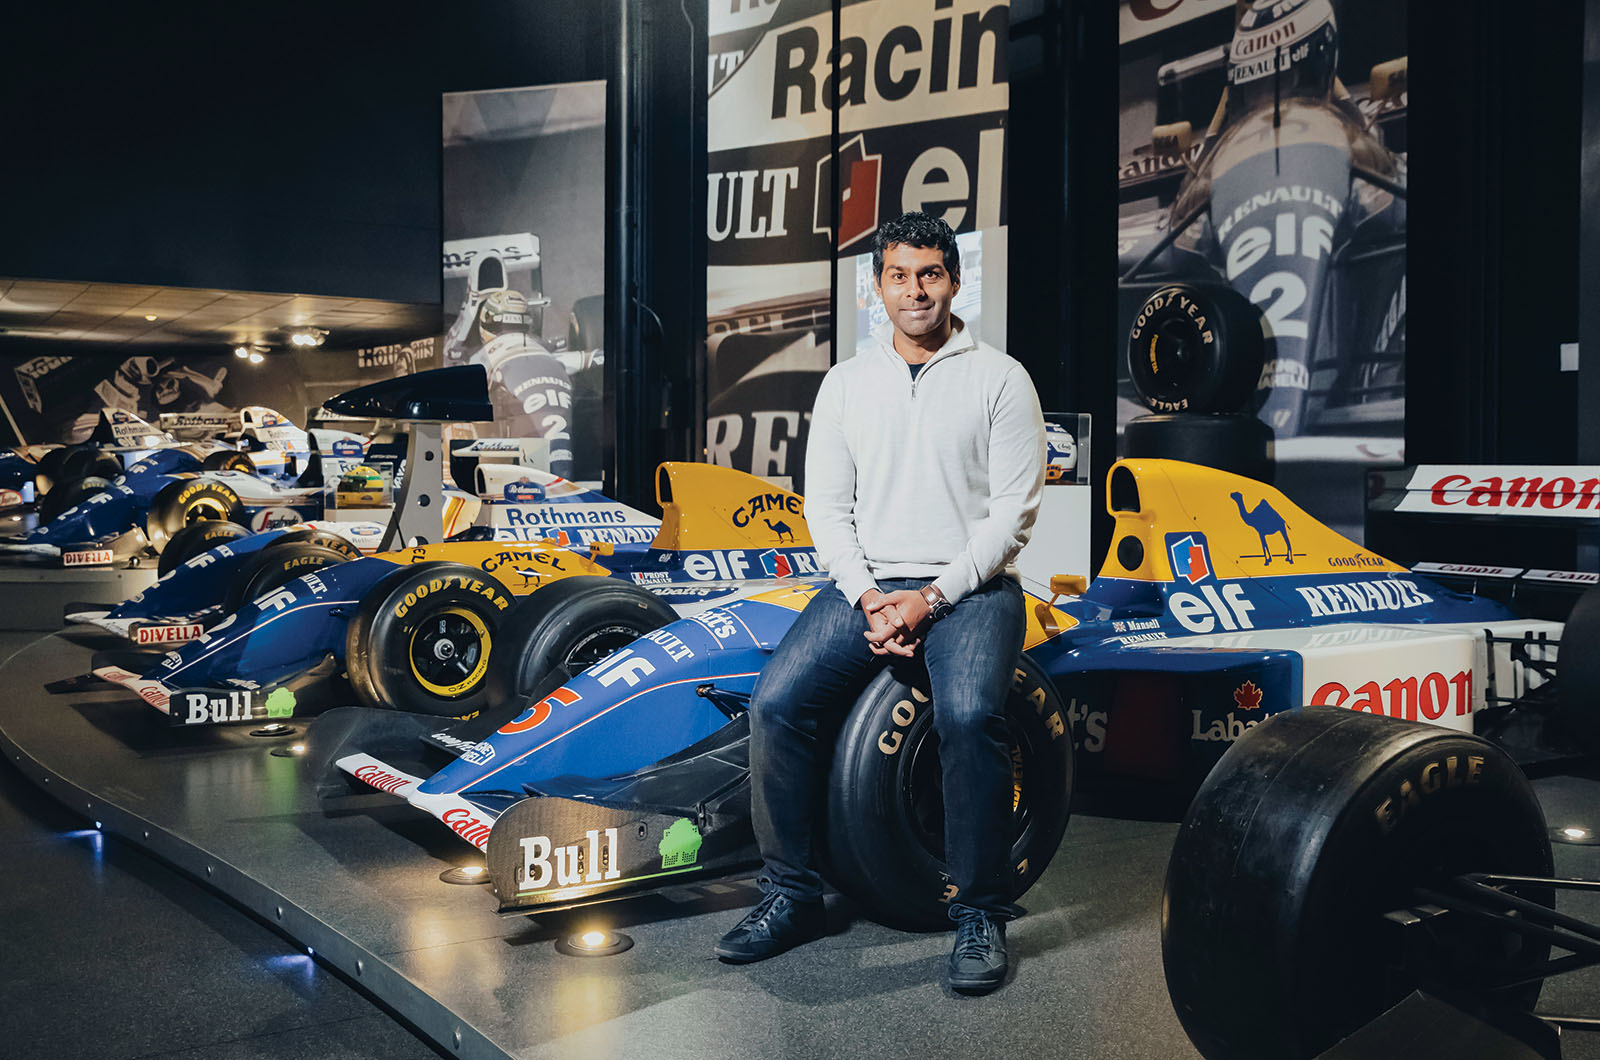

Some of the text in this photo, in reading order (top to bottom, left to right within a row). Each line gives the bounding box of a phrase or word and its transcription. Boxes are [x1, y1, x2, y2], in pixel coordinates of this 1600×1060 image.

[706, 166, 800, 242] ULT
[1217, 185, 1344, 244] RENAULT
[1249, 271, 1309, 339] 2
[1150, 397, 1189, 412] EAGLE
[506, 507, 627, 528] Rothmans
[731, 493, 806, 528] CAME
[65, 551, 112, 564] DIVELLA
[283, 556, 326, 571] EAGLE
[480, 551, 566, 573] CAMEL
[683, 550, 750, 581] elf
[644, 572, 670, 580] PROST
[1168, 583, 1256, 634] elf
[1295, 579, 1435, 618] RENAULT
[139, 625, 202, 644] DIVELLA
[1119, 632, 1168, 645] RENAULT
[1126, 618, 1160, 631] Mansell
[185, 691, 254, 725] Bull
[497, 686, 583, 735] 5
[518, 827, 622, 891] Bull
